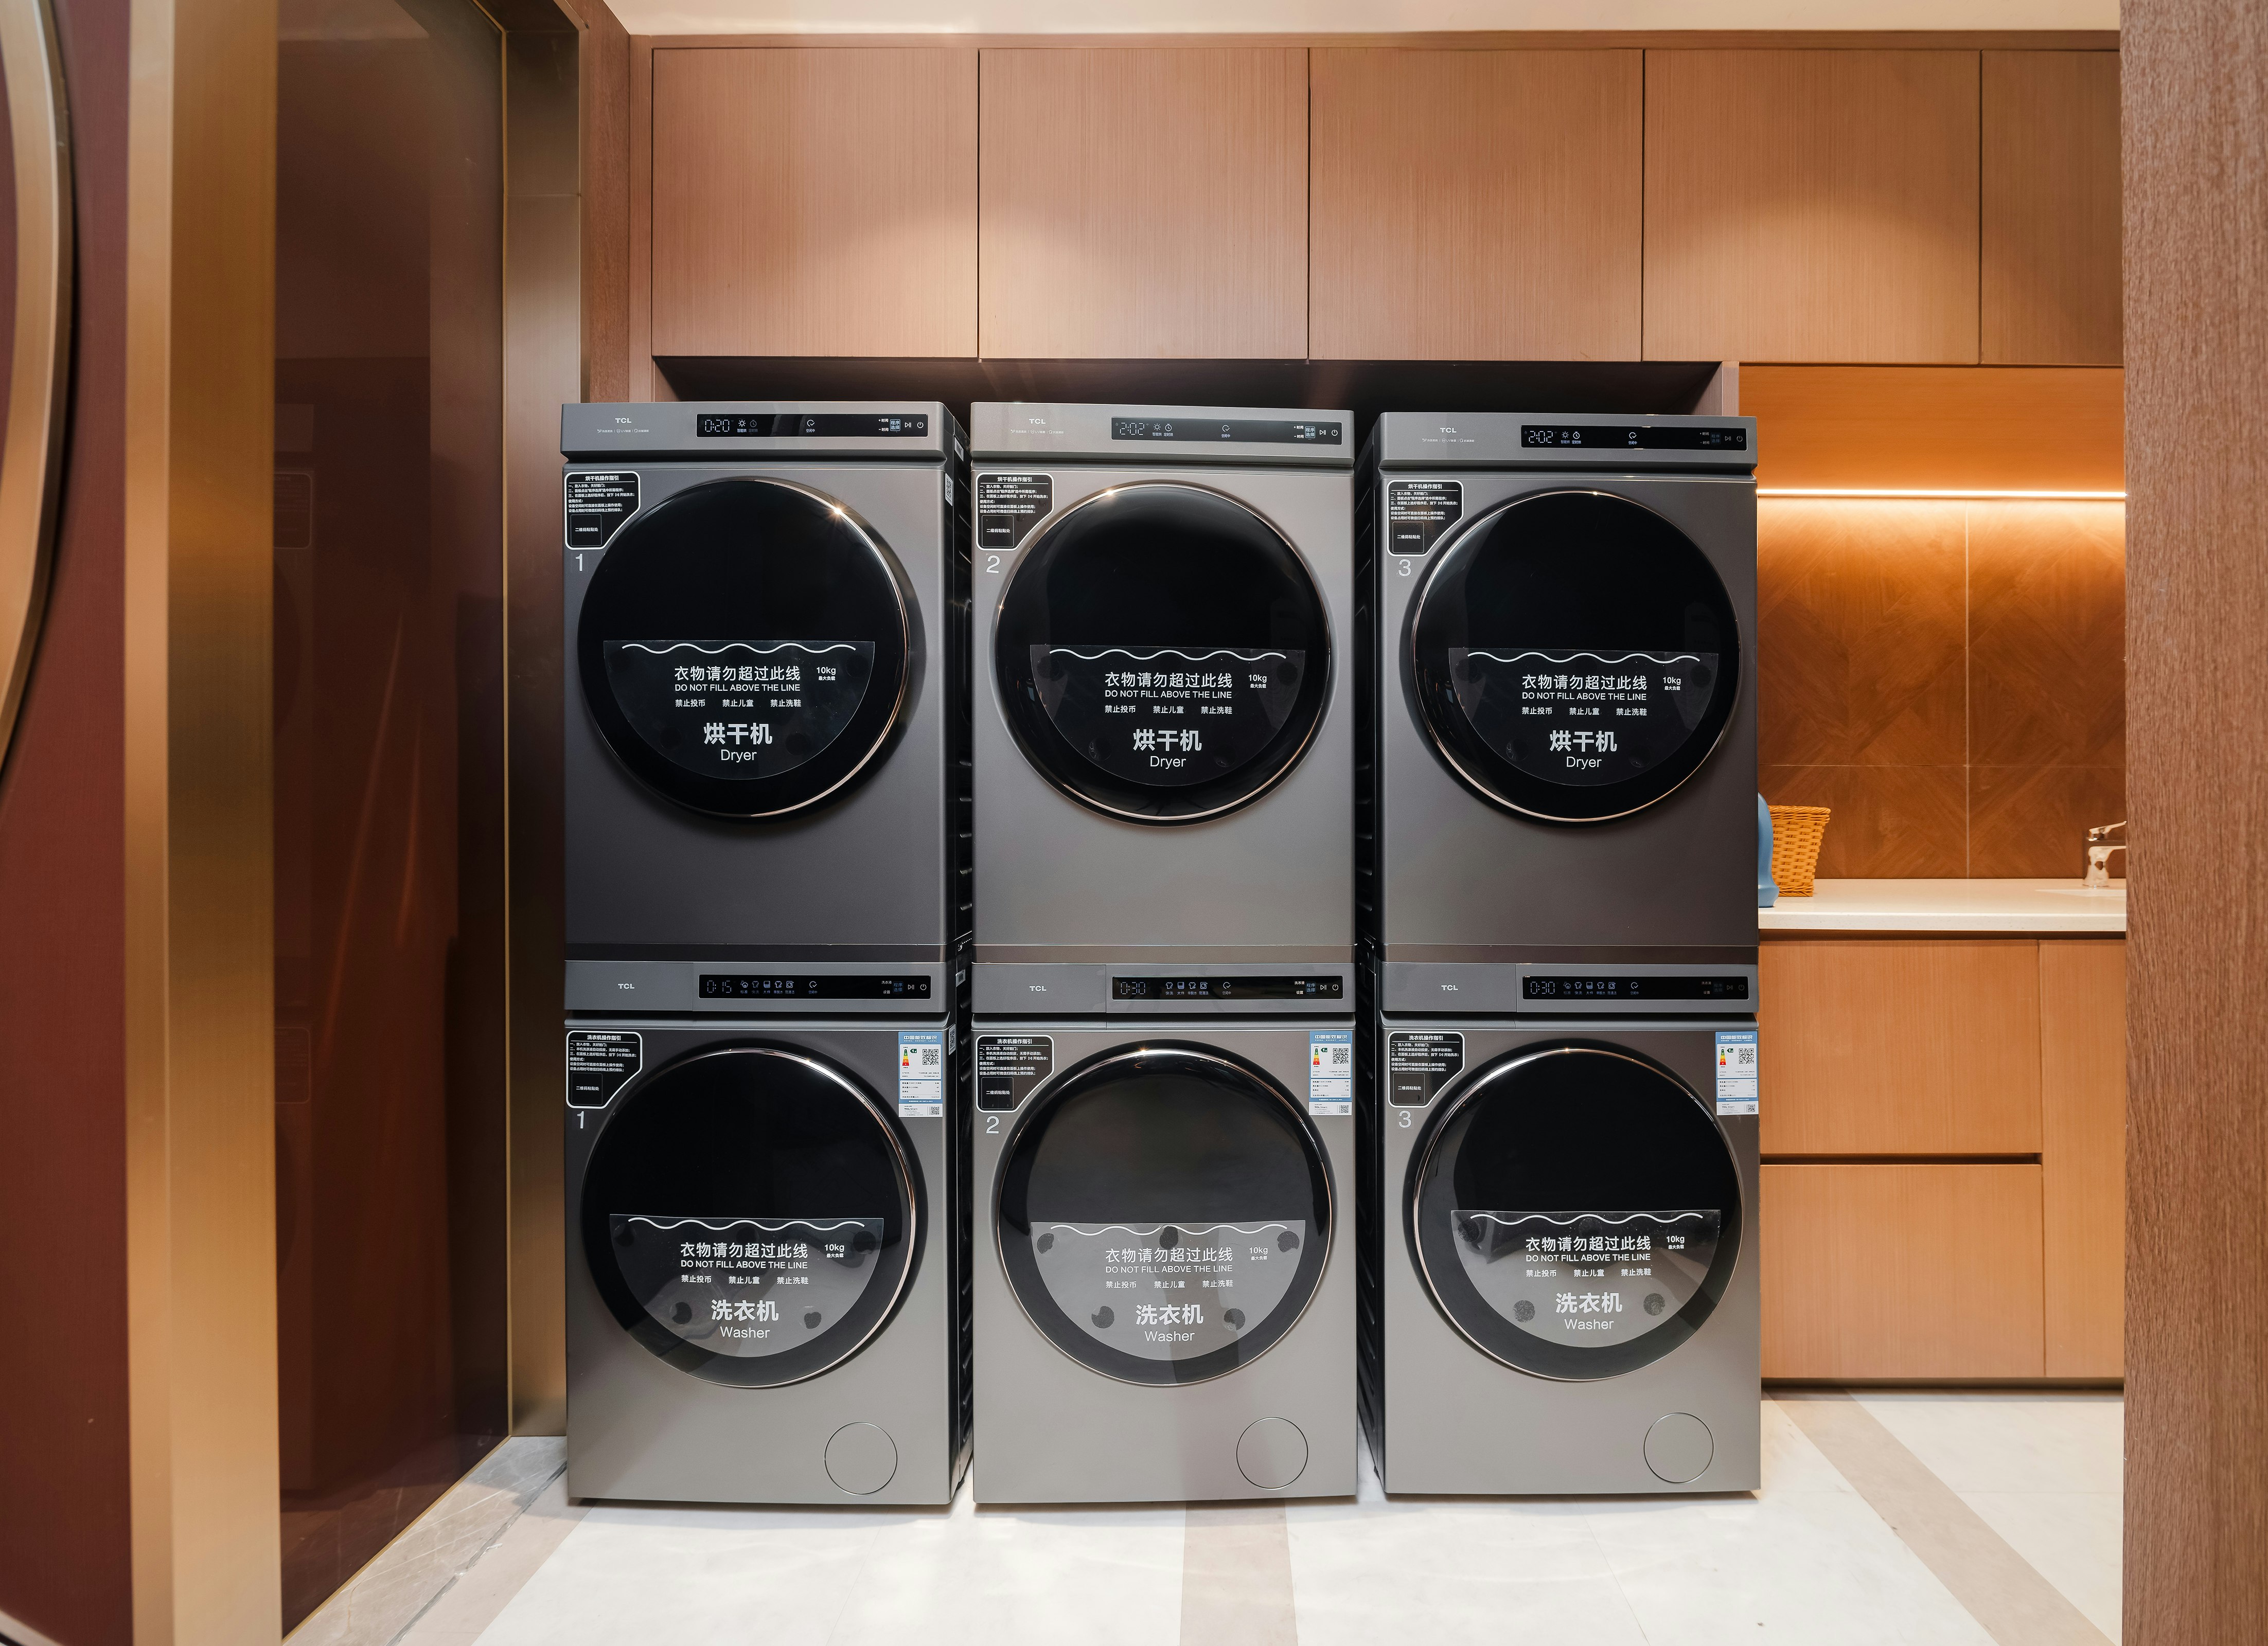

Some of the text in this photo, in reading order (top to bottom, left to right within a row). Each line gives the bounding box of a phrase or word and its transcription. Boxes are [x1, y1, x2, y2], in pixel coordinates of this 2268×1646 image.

[705, 420, 730, 432] 0:20
[1120, 422, 1144, 435] 2:02
[1529, 431, 1553, 443] 2:02
[576, 553, 582, 571] 1
[986, 555, 1000, 573] 2
[1398, 559, 1411, 577] 3
[675, 666, 800, 681] 衣物请勿超过此线
[817, 667, 836, 676] 10kg
[1105, 672, 1232, 688] 衣物请勿超过此线
[1249, 674, 1267, 684] 10kg
[1522, 674, 1647, 690] 衣物请勿超过此线
[1663, 677, 1681, 685] 10kg
[704, 723, 772, 744] 烘干机
[1133, 729, 1202, 751] 烘干机
[1550, 730, 1617, 752] 烘干机
[721, 749, 757, 762] Dryer
[1150, 756, 1186, 769] Dryer
[1567, 757, 1602, 770] Dryer
[707, 980, 731, 993] 0:15
[1121, 982, 1145, 994] 0:30
[1531, 981, 1555, 994] 0:30
[577, 1111, 584, 1129] 1
[986, 1116, 999, 1134] 2
[1399, 1111, 1411, 1128] 3
[1526, 1235, 1651, 1251] 衣物请勿超过此线
[1667, 1236, 1685, 1245] 10kg
[681, 1242, 808, 1259] 衣物请勿超过此线
[825, 1244, 844, 1254] 10kg
[1106, 1246, 1233, 1264] 衣物请勿超过此线
[1249, 1247, 1268, 1256] 10kg
[788, 1260, 807, 1268] LINE
[1621, 1268, 1651, 1276] 禁止洗鞋
[681, 1275, 711, 1283] 禁止投币
[1556, 1292, 1622, 1313] 洗衣机
[711, 1299, 778, 1321] 洗衣机
[1136, 1304, 1203, 1325] 洗衣机
[1565, 1319, 1614, 1330] Washer
[720, 1326, 770, 1338] Washer
[1145, 1331, 1195, 1341] Washer
